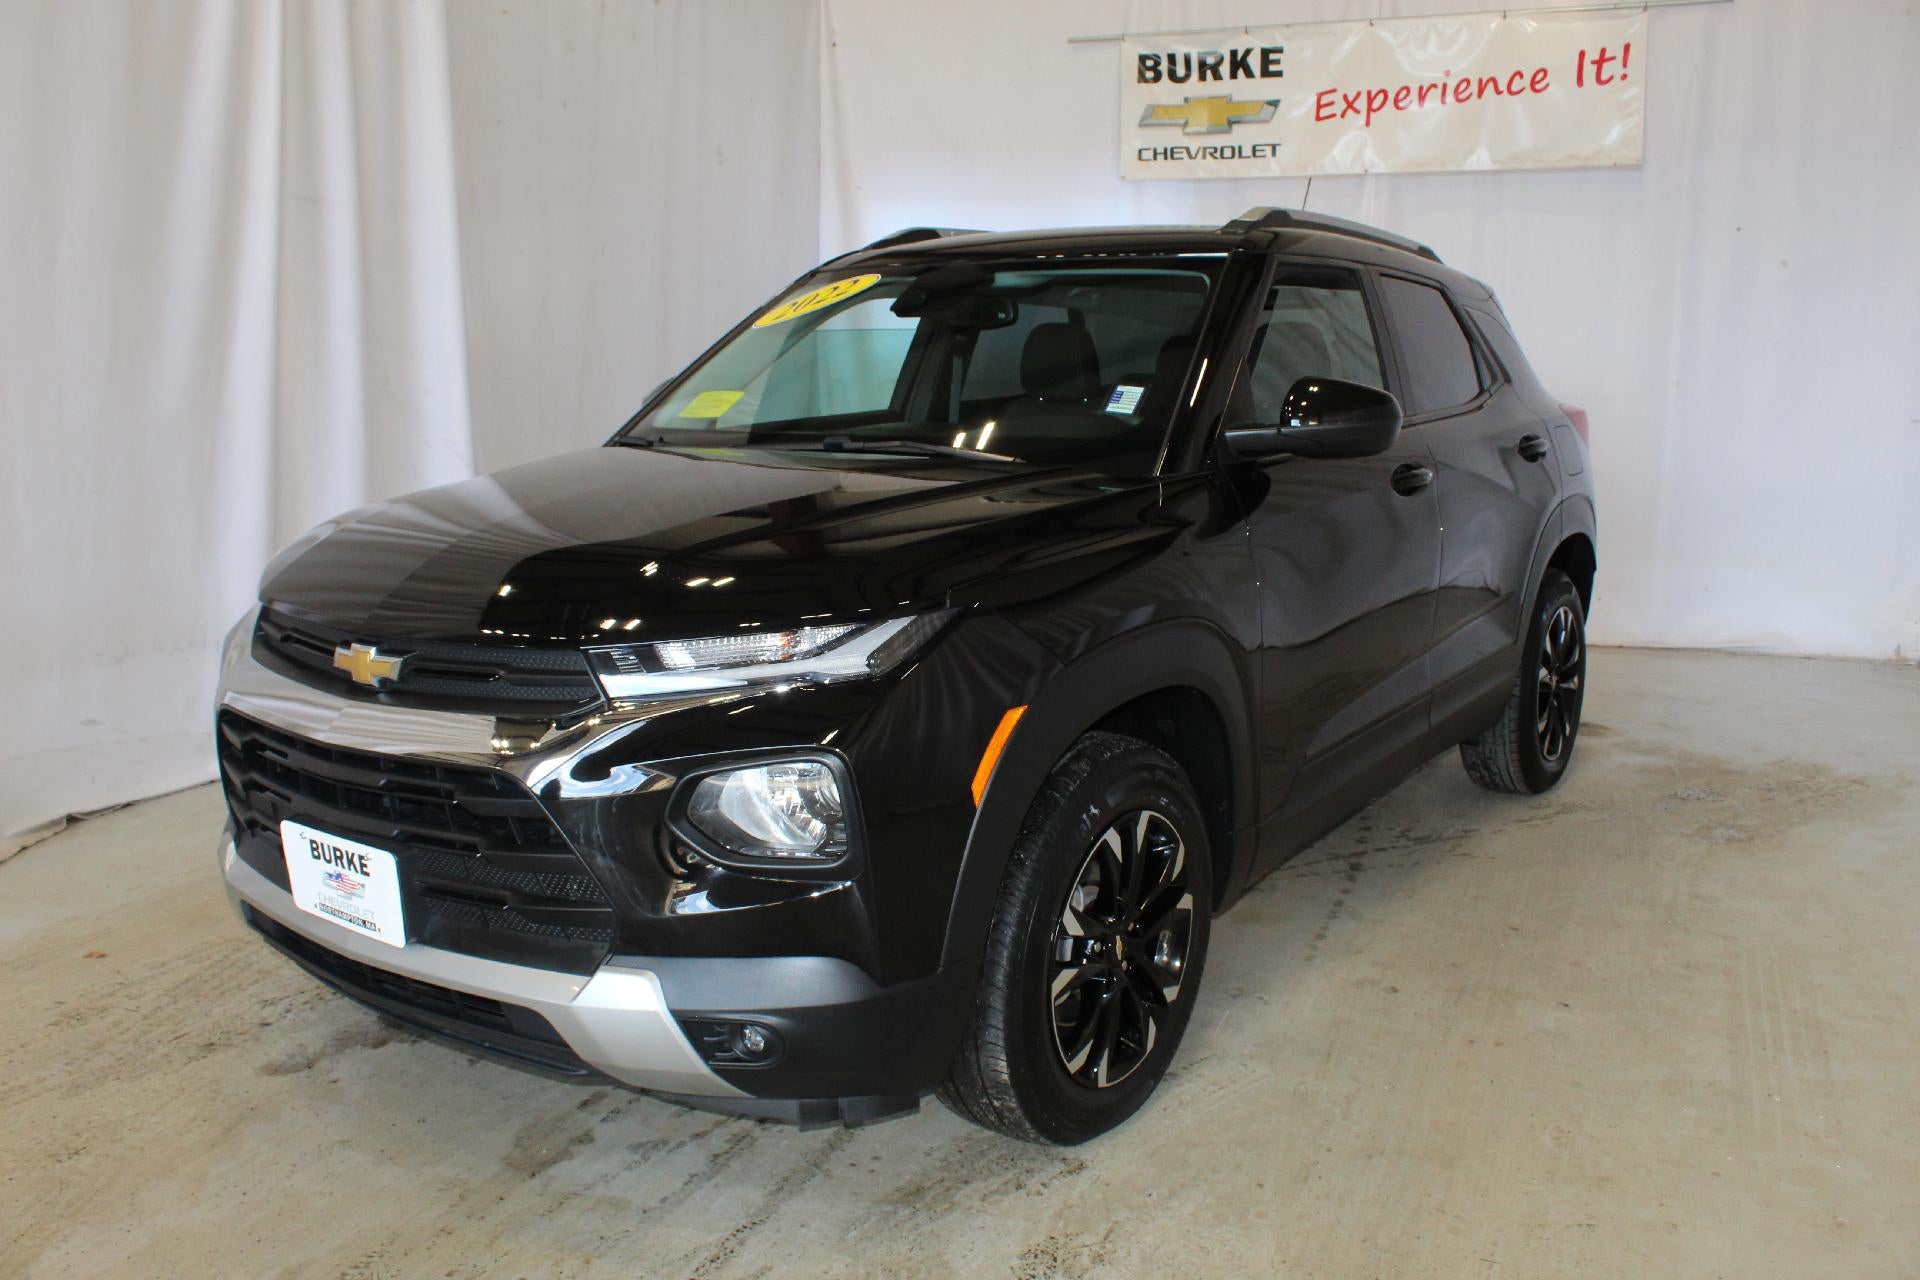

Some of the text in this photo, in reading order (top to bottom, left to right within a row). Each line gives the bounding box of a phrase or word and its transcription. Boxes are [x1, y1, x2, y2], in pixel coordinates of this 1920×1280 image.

[1137, 46, 1284, 84] BURKE
[1314, 42, 1631, 127] Experience It!
[1138, 143, 1281, 161] CHEVROLET
[309, 838, 370, 877] BURKE
